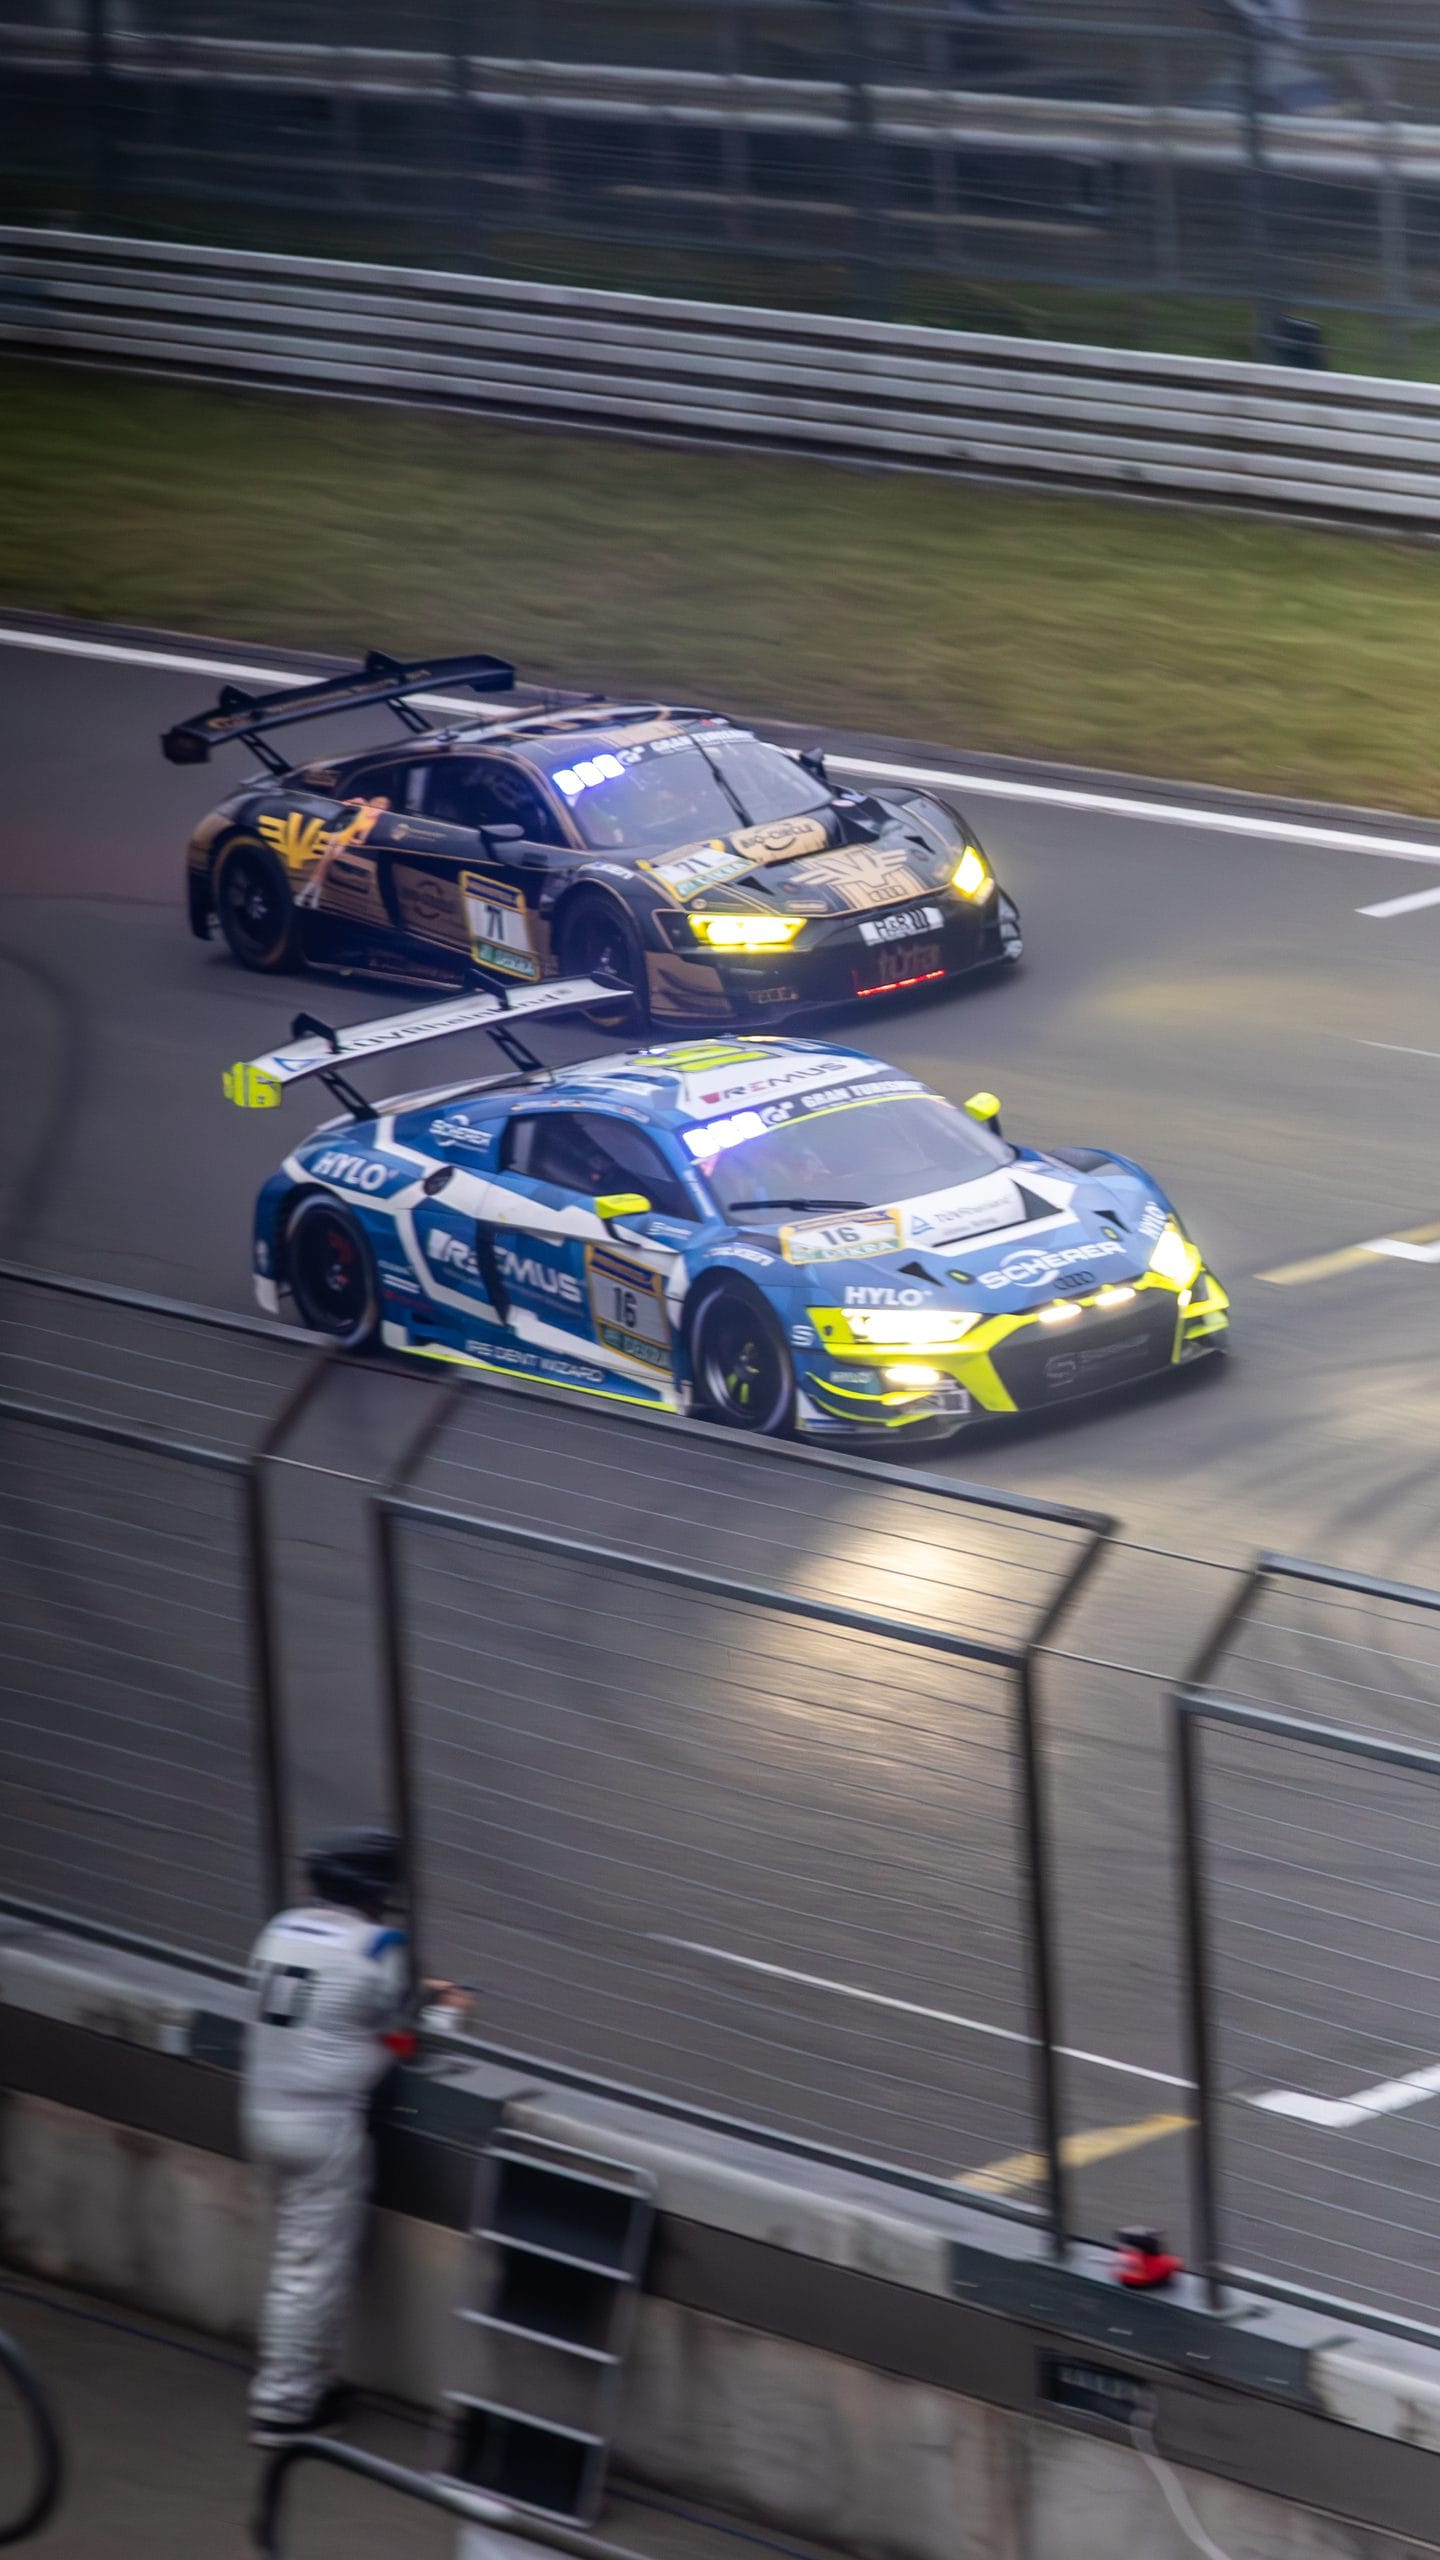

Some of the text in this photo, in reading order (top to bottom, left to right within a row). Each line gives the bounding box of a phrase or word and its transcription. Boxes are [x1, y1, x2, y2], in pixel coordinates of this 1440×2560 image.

[673, 858, 712, 874] 71
[485, 904, 504, 940] 71
[723, 1062, 848, 1098] REMUS
[820, 1226, 861, 1246] 16
[976, 1241, 1127, 1289] SCHERER
[613, 1286, 637, 1329] 16
[844, 1286, 924, 1306] HYLO
